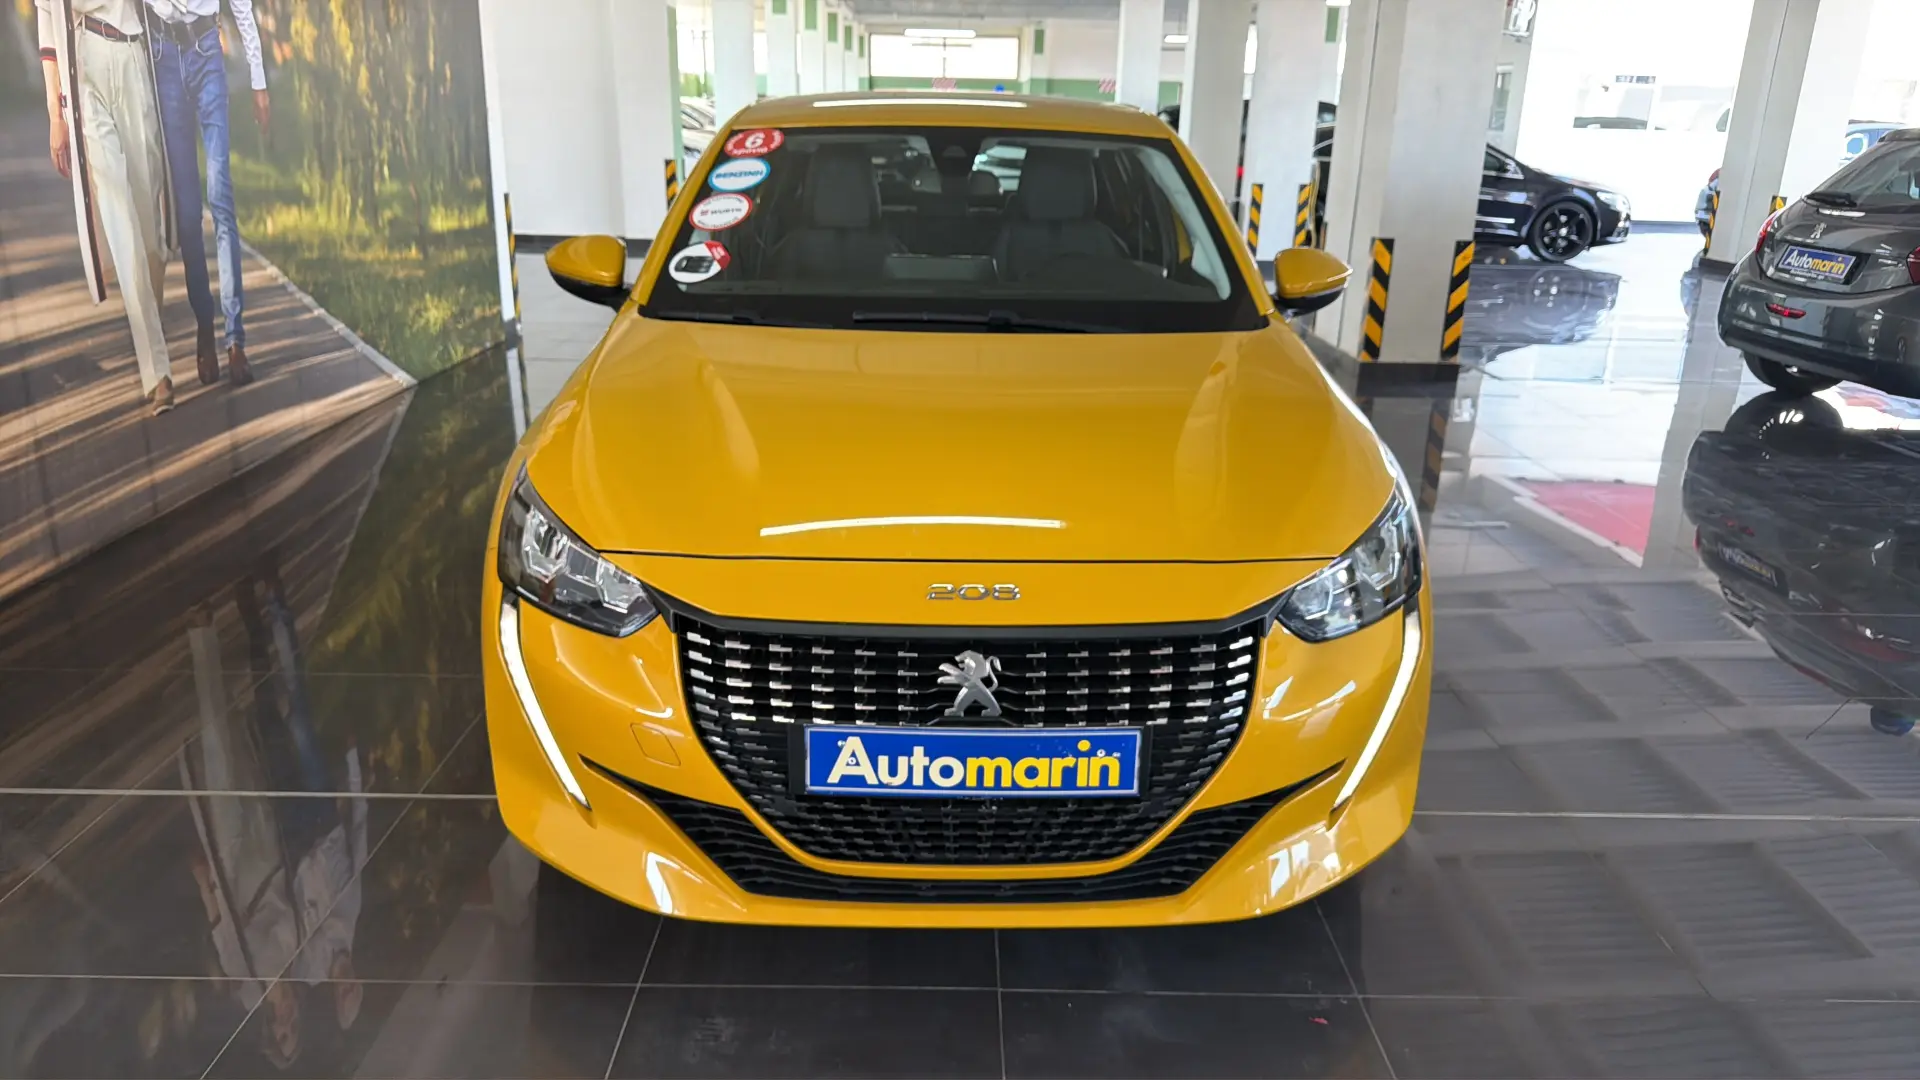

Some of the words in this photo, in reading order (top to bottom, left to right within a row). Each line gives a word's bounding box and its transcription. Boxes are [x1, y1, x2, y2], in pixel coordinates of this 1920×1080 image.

[744, 131, 766, 149] 6
[1784, 249, 1845, 275] Automarin
[926, 583, 1021, 601] 208
[826, 736, 1121, 789] Automarin
